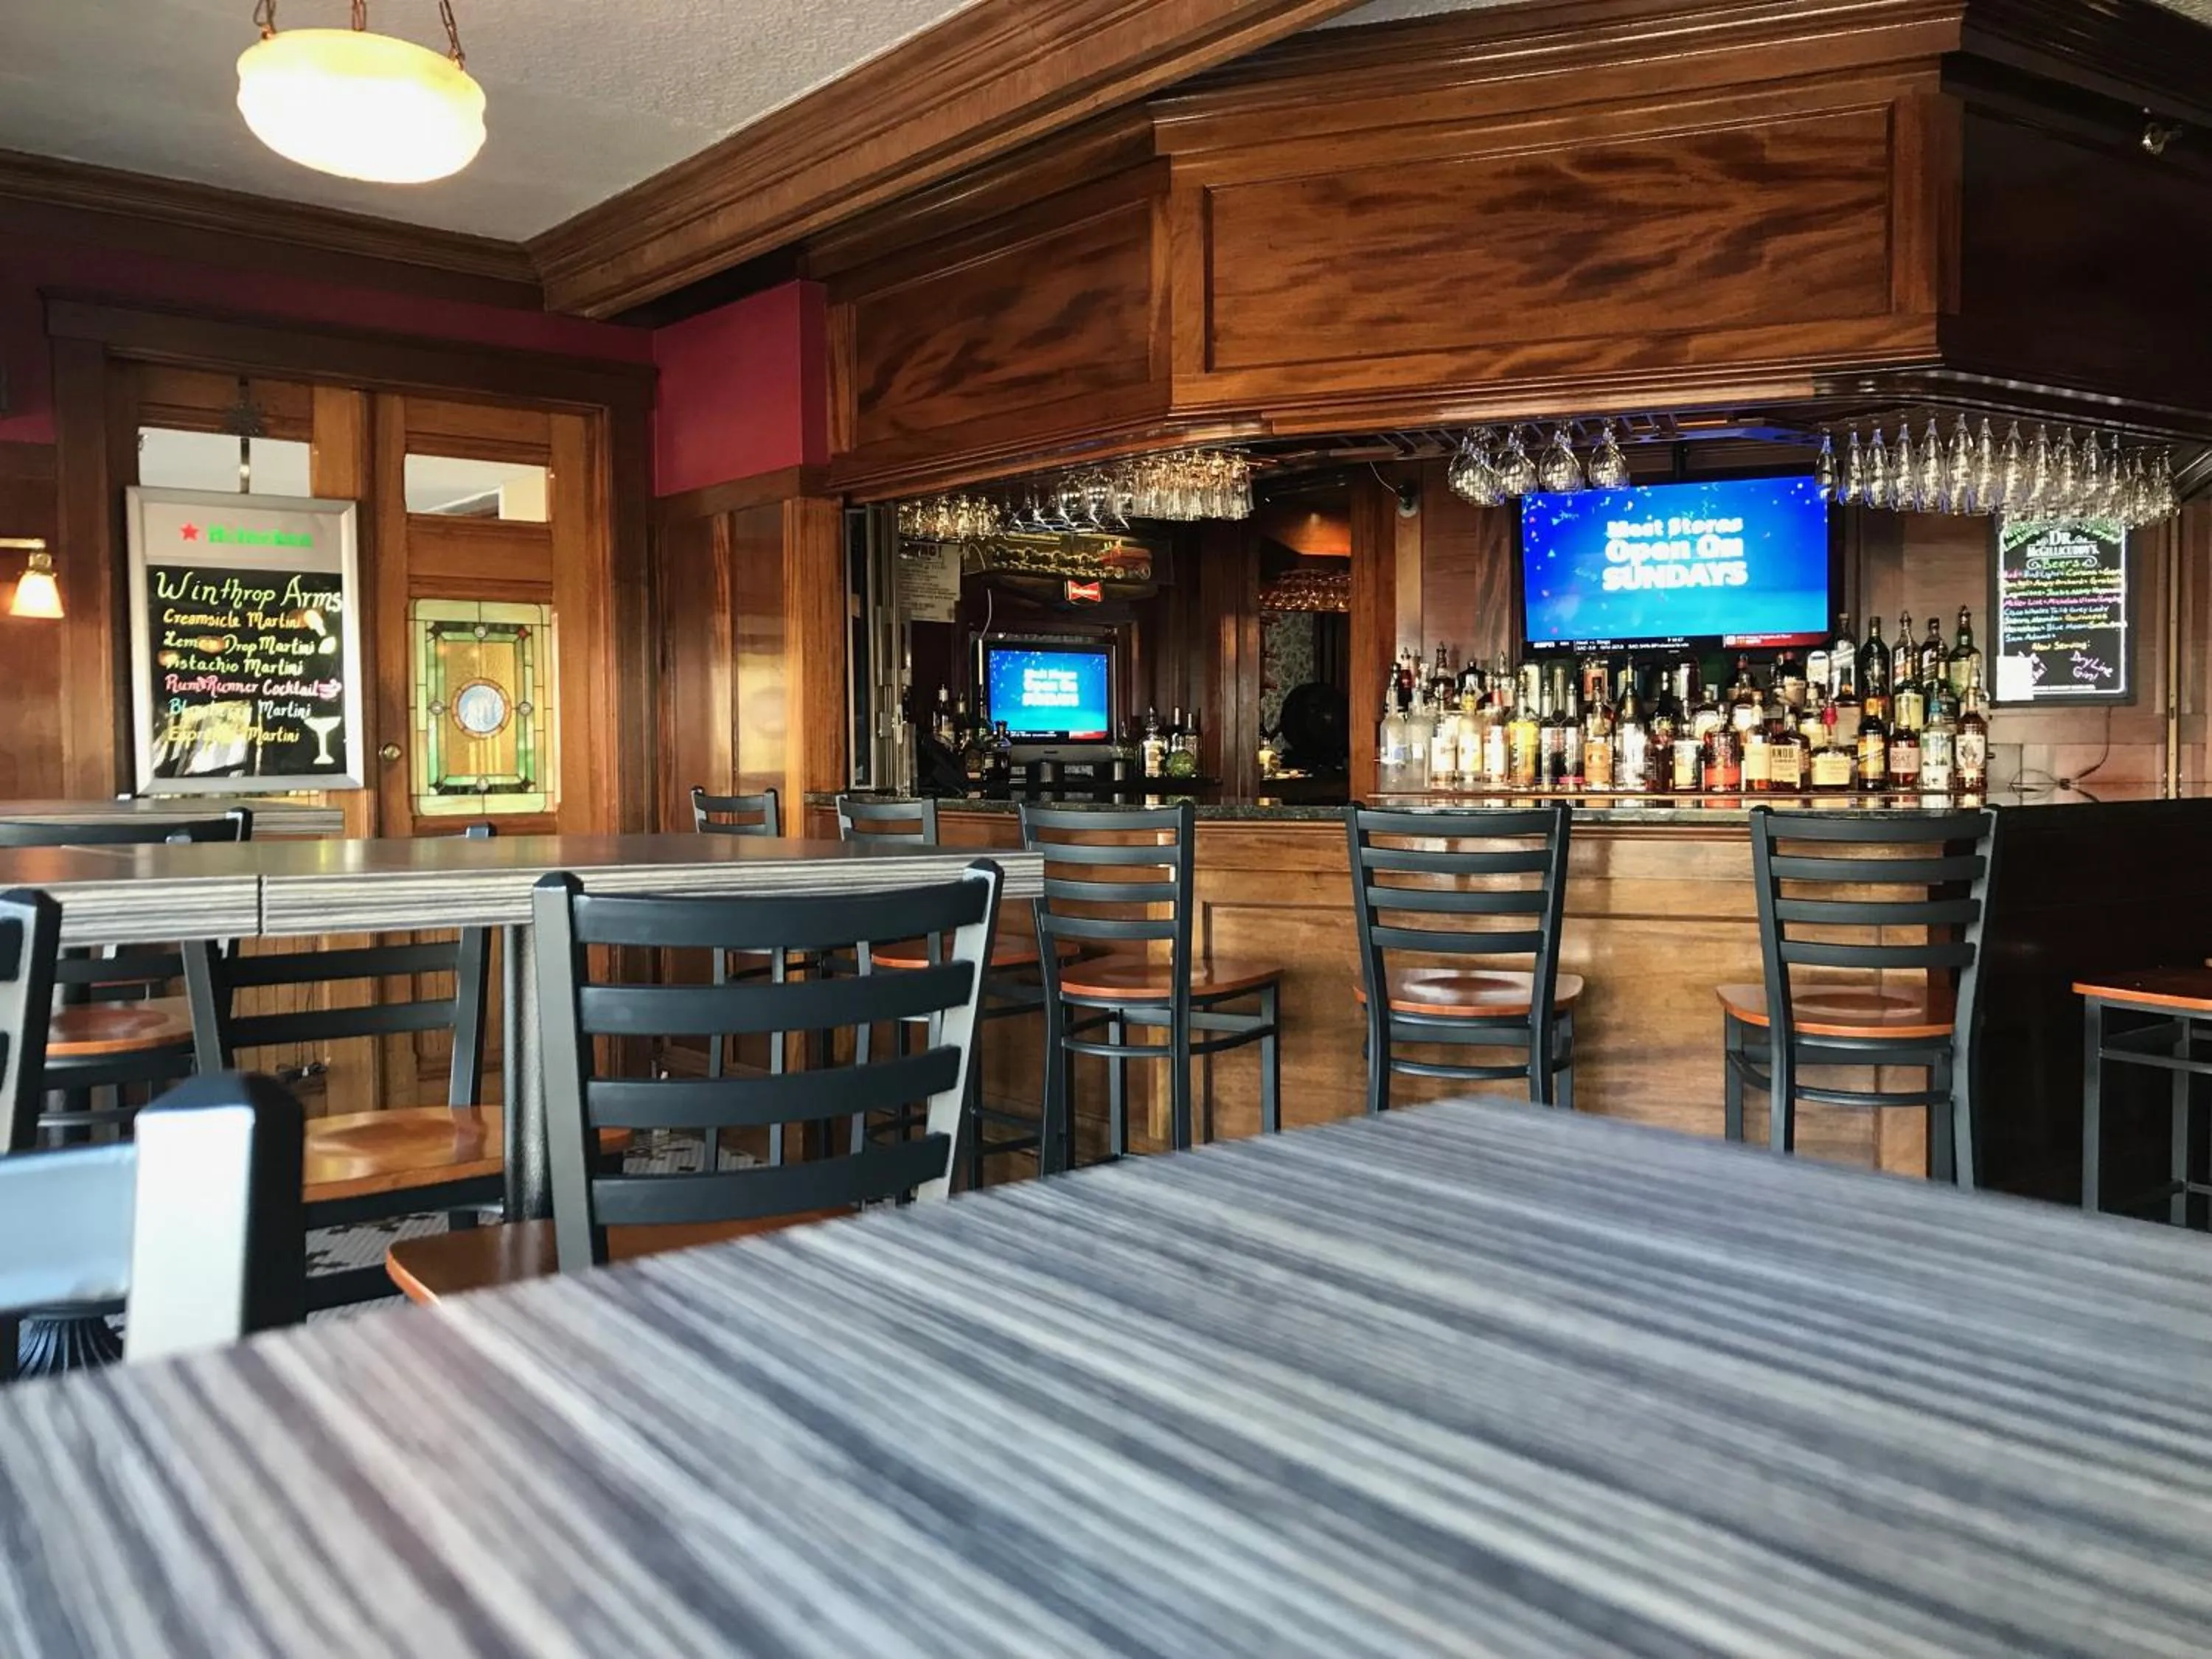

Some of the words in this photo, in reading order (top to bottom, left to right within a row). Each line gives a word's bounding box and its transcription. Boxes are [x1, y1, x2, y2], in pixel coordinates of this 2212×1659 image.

[1605, 538, 1691, 566] Open
[1696, 534, 1744, 559] On
[1603, 560, 1748, 591] SUNDAYS
[156, 571, 276, 611] Winthrop
[280, 574, 343, 612] Arms
[163, 608, 241, 627] Creamsicle
[246, 611, 300, 630] Martini
[223, 634, 257, 657] Drop
[259, 636, 315, 655] Martini
[243, 658, 303, 678] Martini
[262, 678, 319, 698] Cocktail
[258, 698, 313, 718] Martini
[247, 726, 299, 745] Martini
